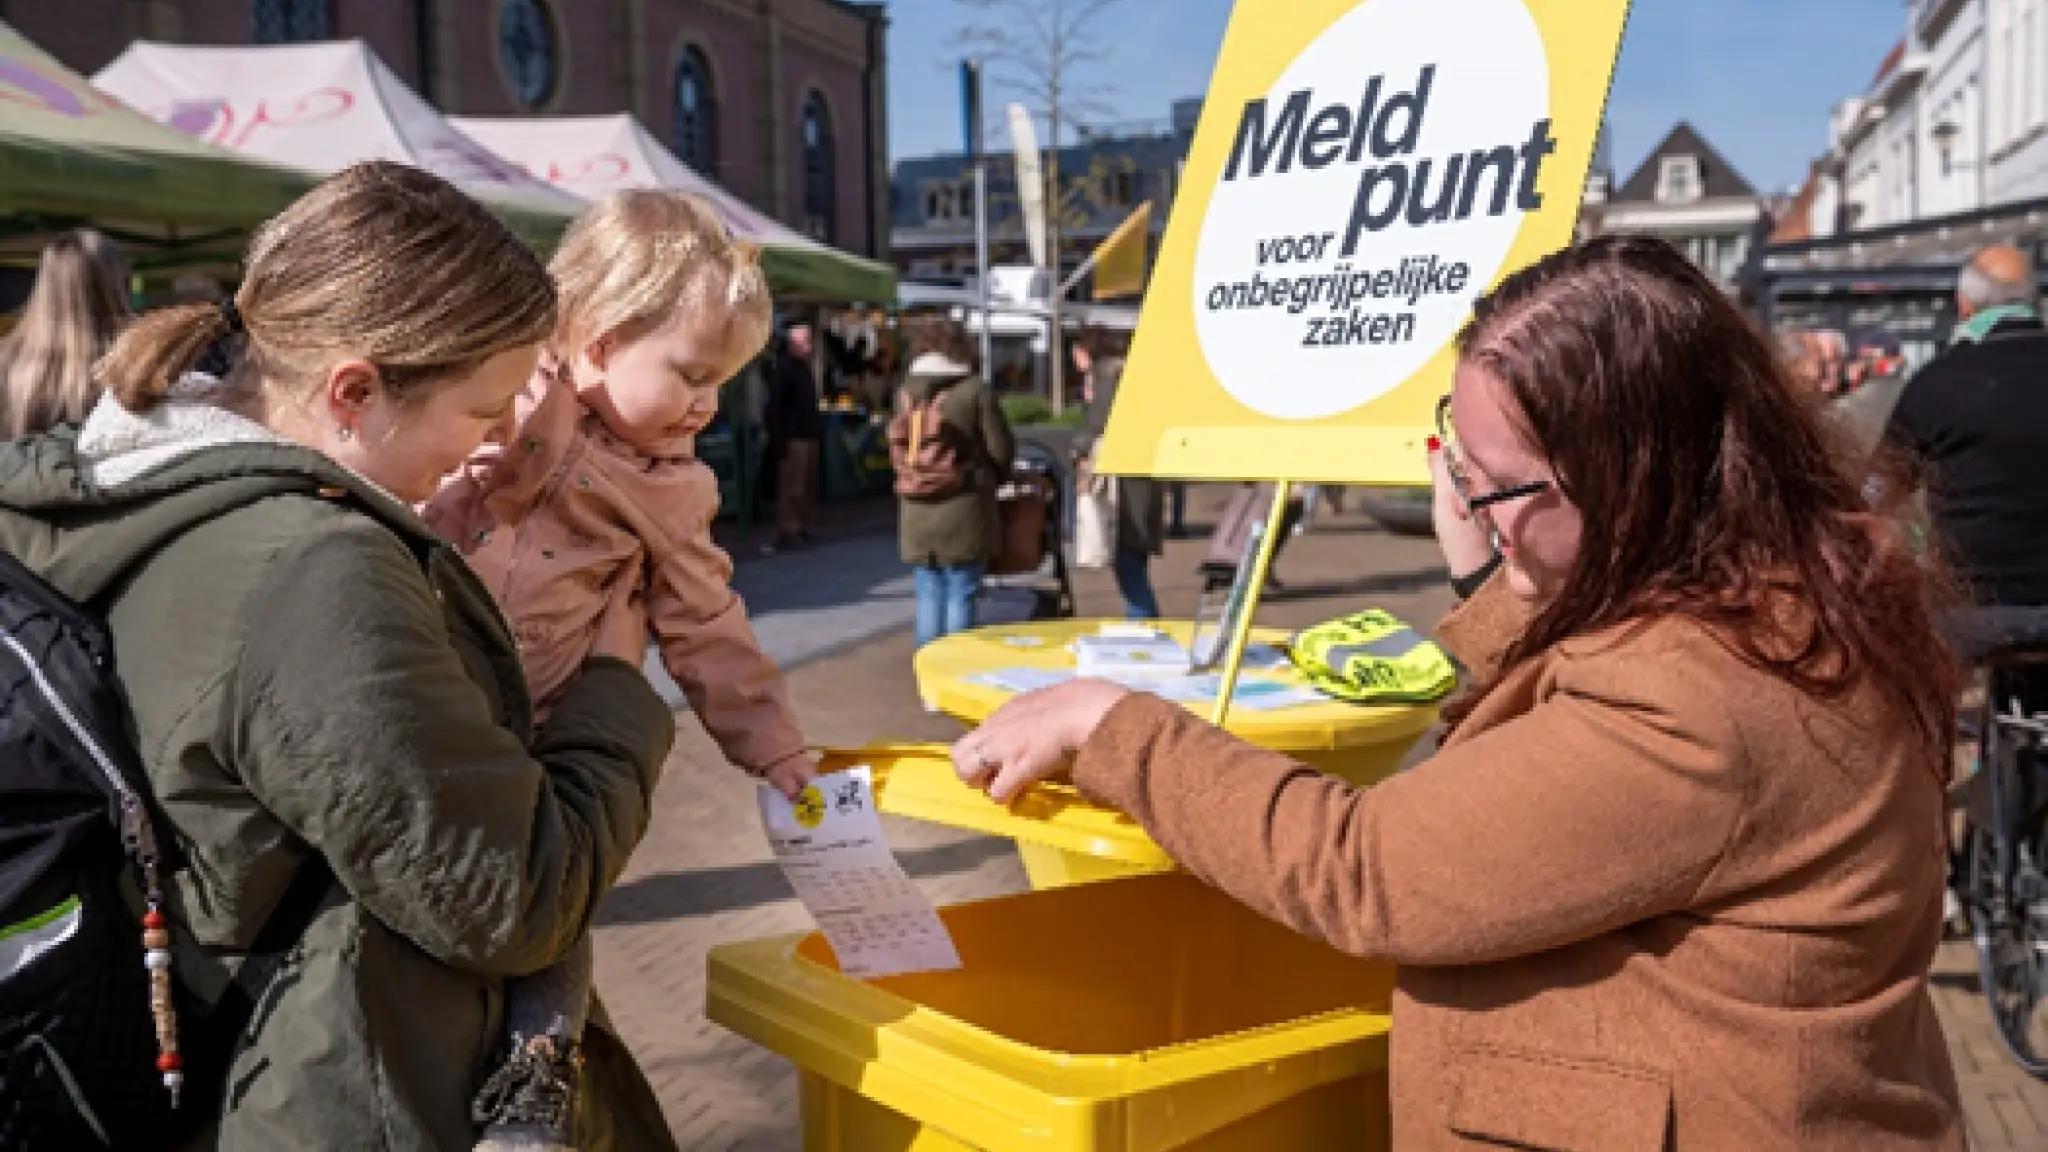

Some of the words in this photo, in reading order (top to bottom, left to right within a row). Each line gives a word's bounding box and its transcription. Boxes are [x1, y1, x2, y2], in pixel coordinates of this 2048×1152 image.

[1223, 63, 1436, 182] Meld
[1341, 118, 1558, 257] punt
[1257, 233, 1335, 265] voor
[1207, 256, 1469, 313] onbegrijpelijke
[1302, 311, 1416, 347] zaken
